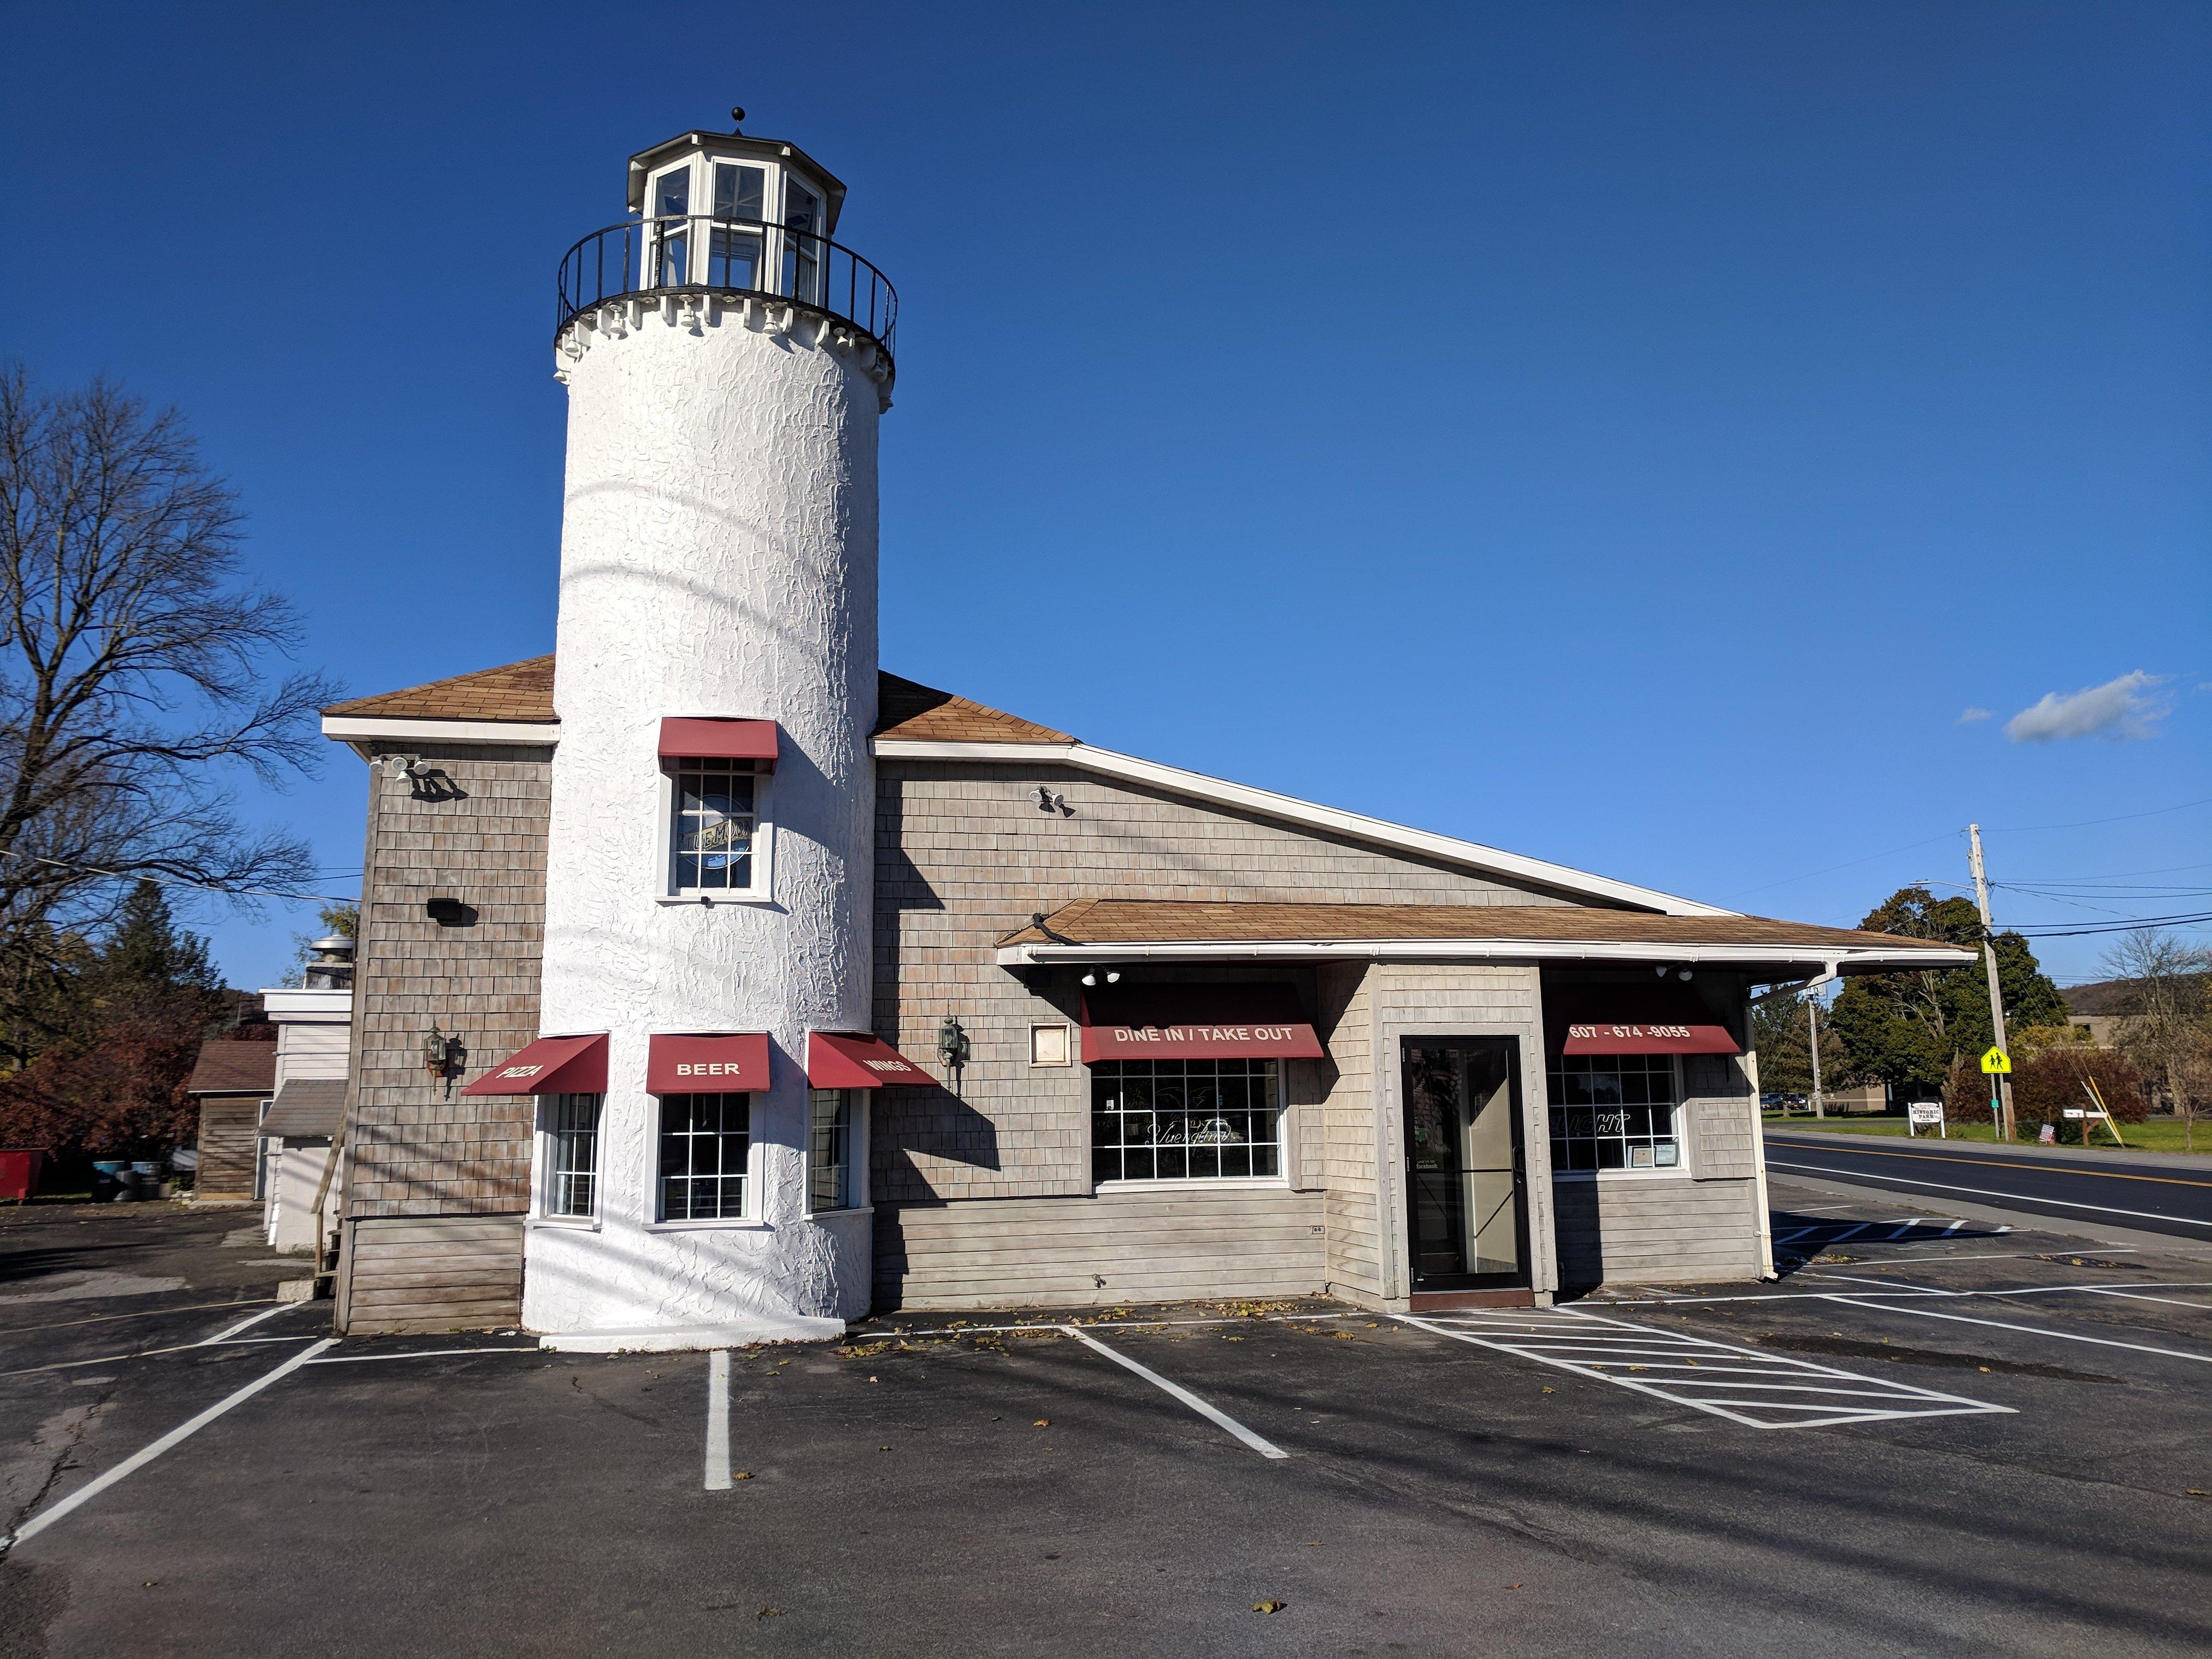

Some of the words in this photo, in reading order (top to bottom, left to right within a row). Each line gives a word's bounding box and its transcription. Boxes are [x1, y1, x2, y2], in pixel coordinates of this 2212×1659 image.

[1114, 1029, 1161, 1042] DINE
[1164, 1028, 1185, 1041] IN
[1198, 1028, 1250, 1041] TAKE
[1254, 1028, 1292, 1040] OUT
[1569, 1026, 1597, 1038] 607
[1612, 1026, 1643, 1037] 674
[1646, 1026, 1690, 1037] -9055
[677, 1063, 740, 1075] BEER
[862, 1060, 912, 1071] WINGS
[495, 1065, 544, 1079] PIZZA
